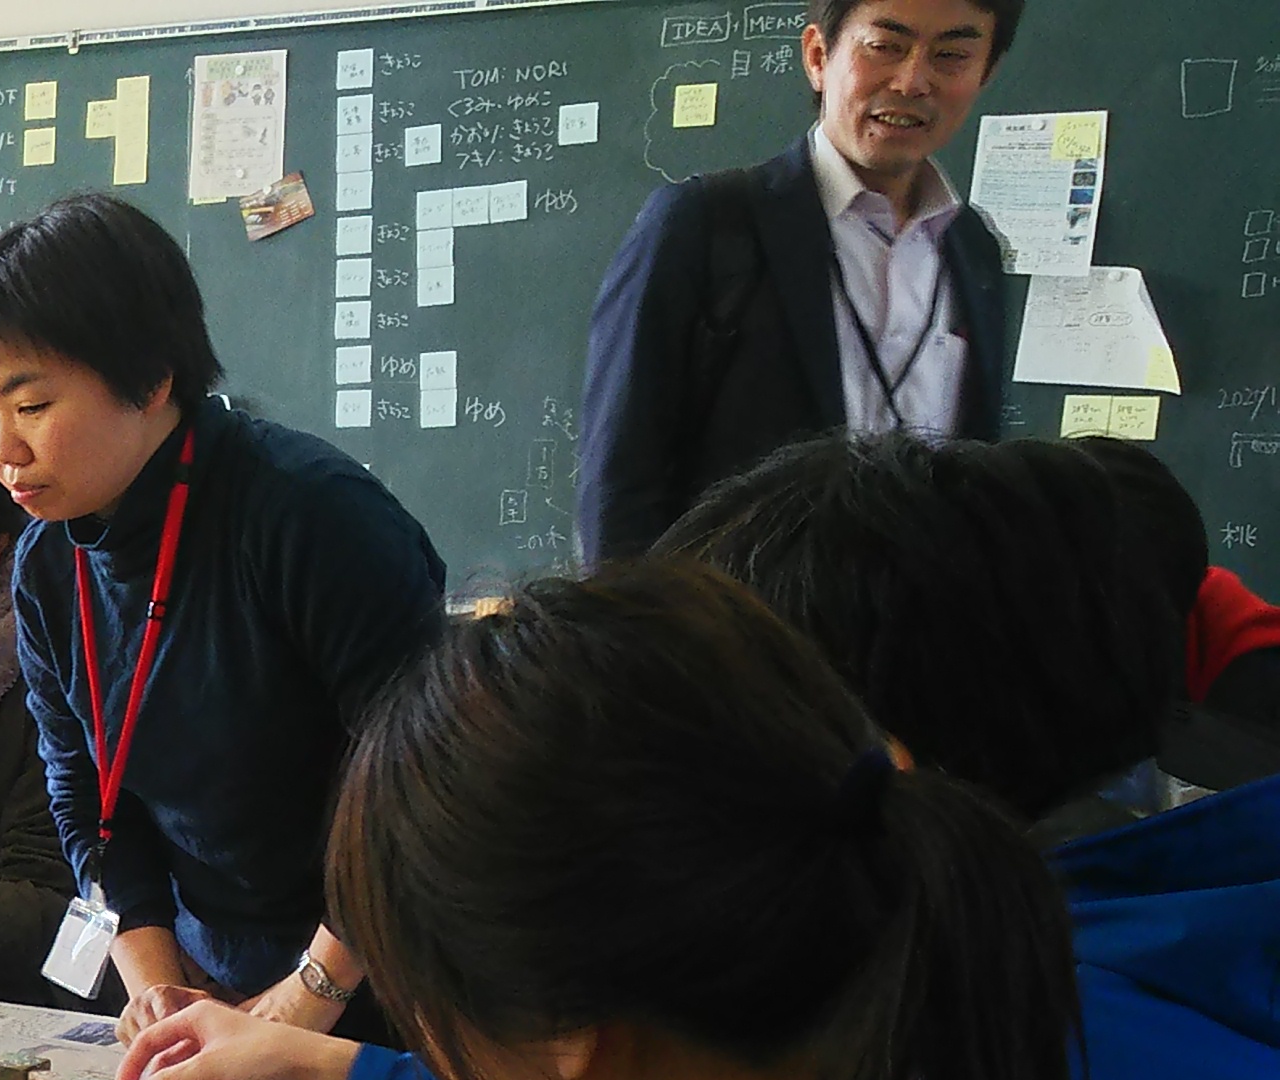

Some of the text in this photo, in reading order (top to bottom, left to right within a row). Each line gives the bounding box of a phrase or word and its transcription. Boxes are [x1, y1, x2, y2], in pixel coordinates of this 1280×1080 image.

[672, 12, 806, 40] IDEA MEANS
[516, 60, 567, 82] NORI
[731, 45, 793, 79] 目標
[535, 189, 578, 213] ゆめ
[381, 356, 416, 378] ゆめ
[465, 396, 506, 427] ゆめ
